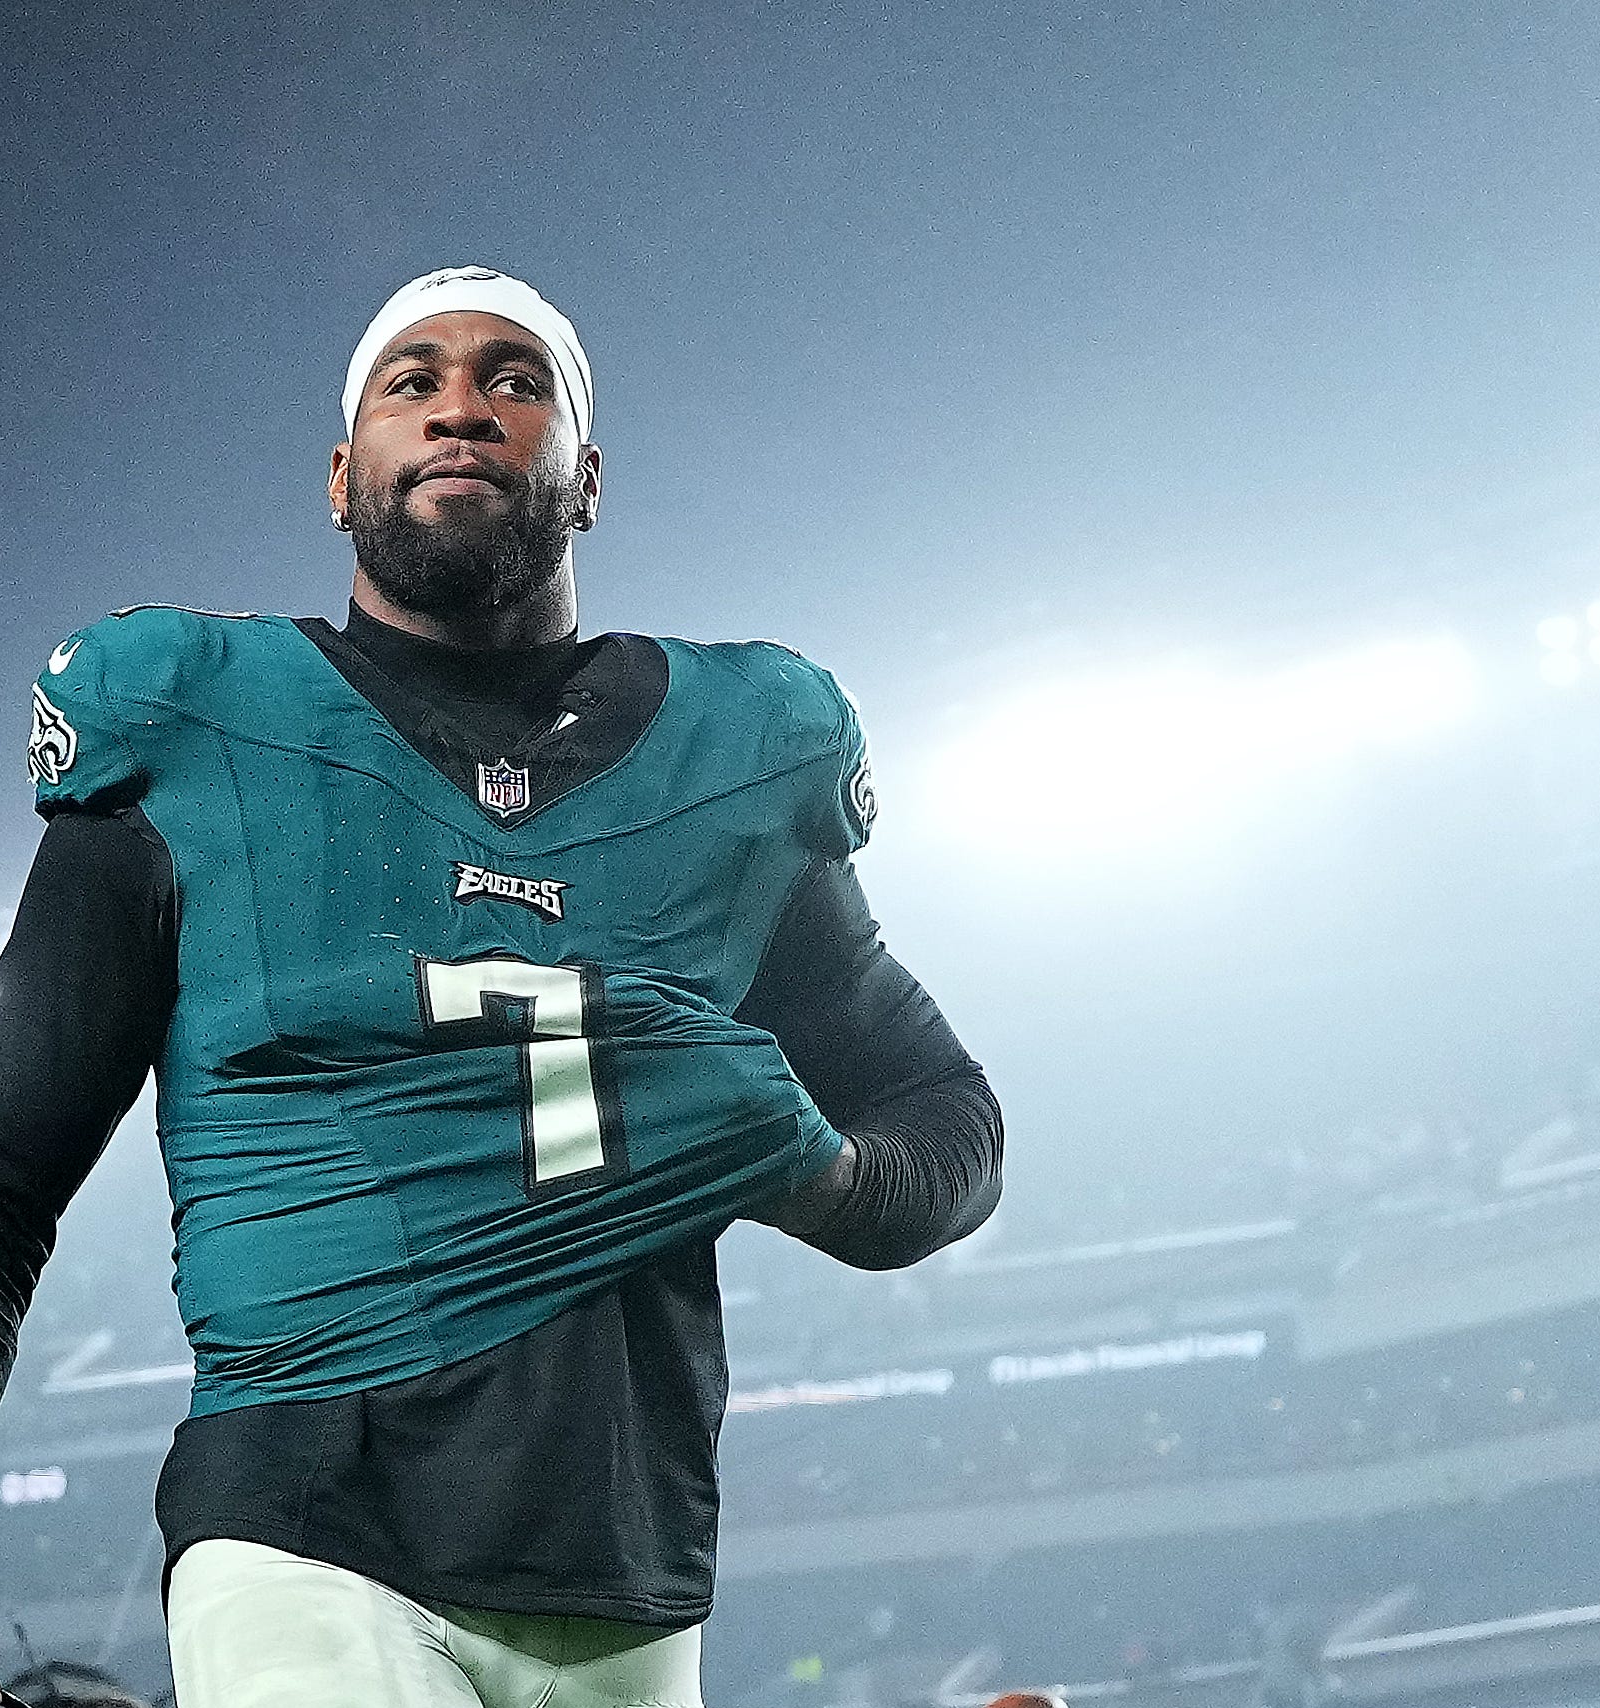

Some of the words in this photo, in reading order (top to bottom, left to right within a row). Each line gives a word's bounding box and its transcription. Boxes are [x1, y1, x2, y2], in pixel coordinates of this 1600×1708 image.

[489, 783, 523, 806] NFL
[454, 861, 568, 920] EAGLES
[420, 957, 612, 1191] 7
